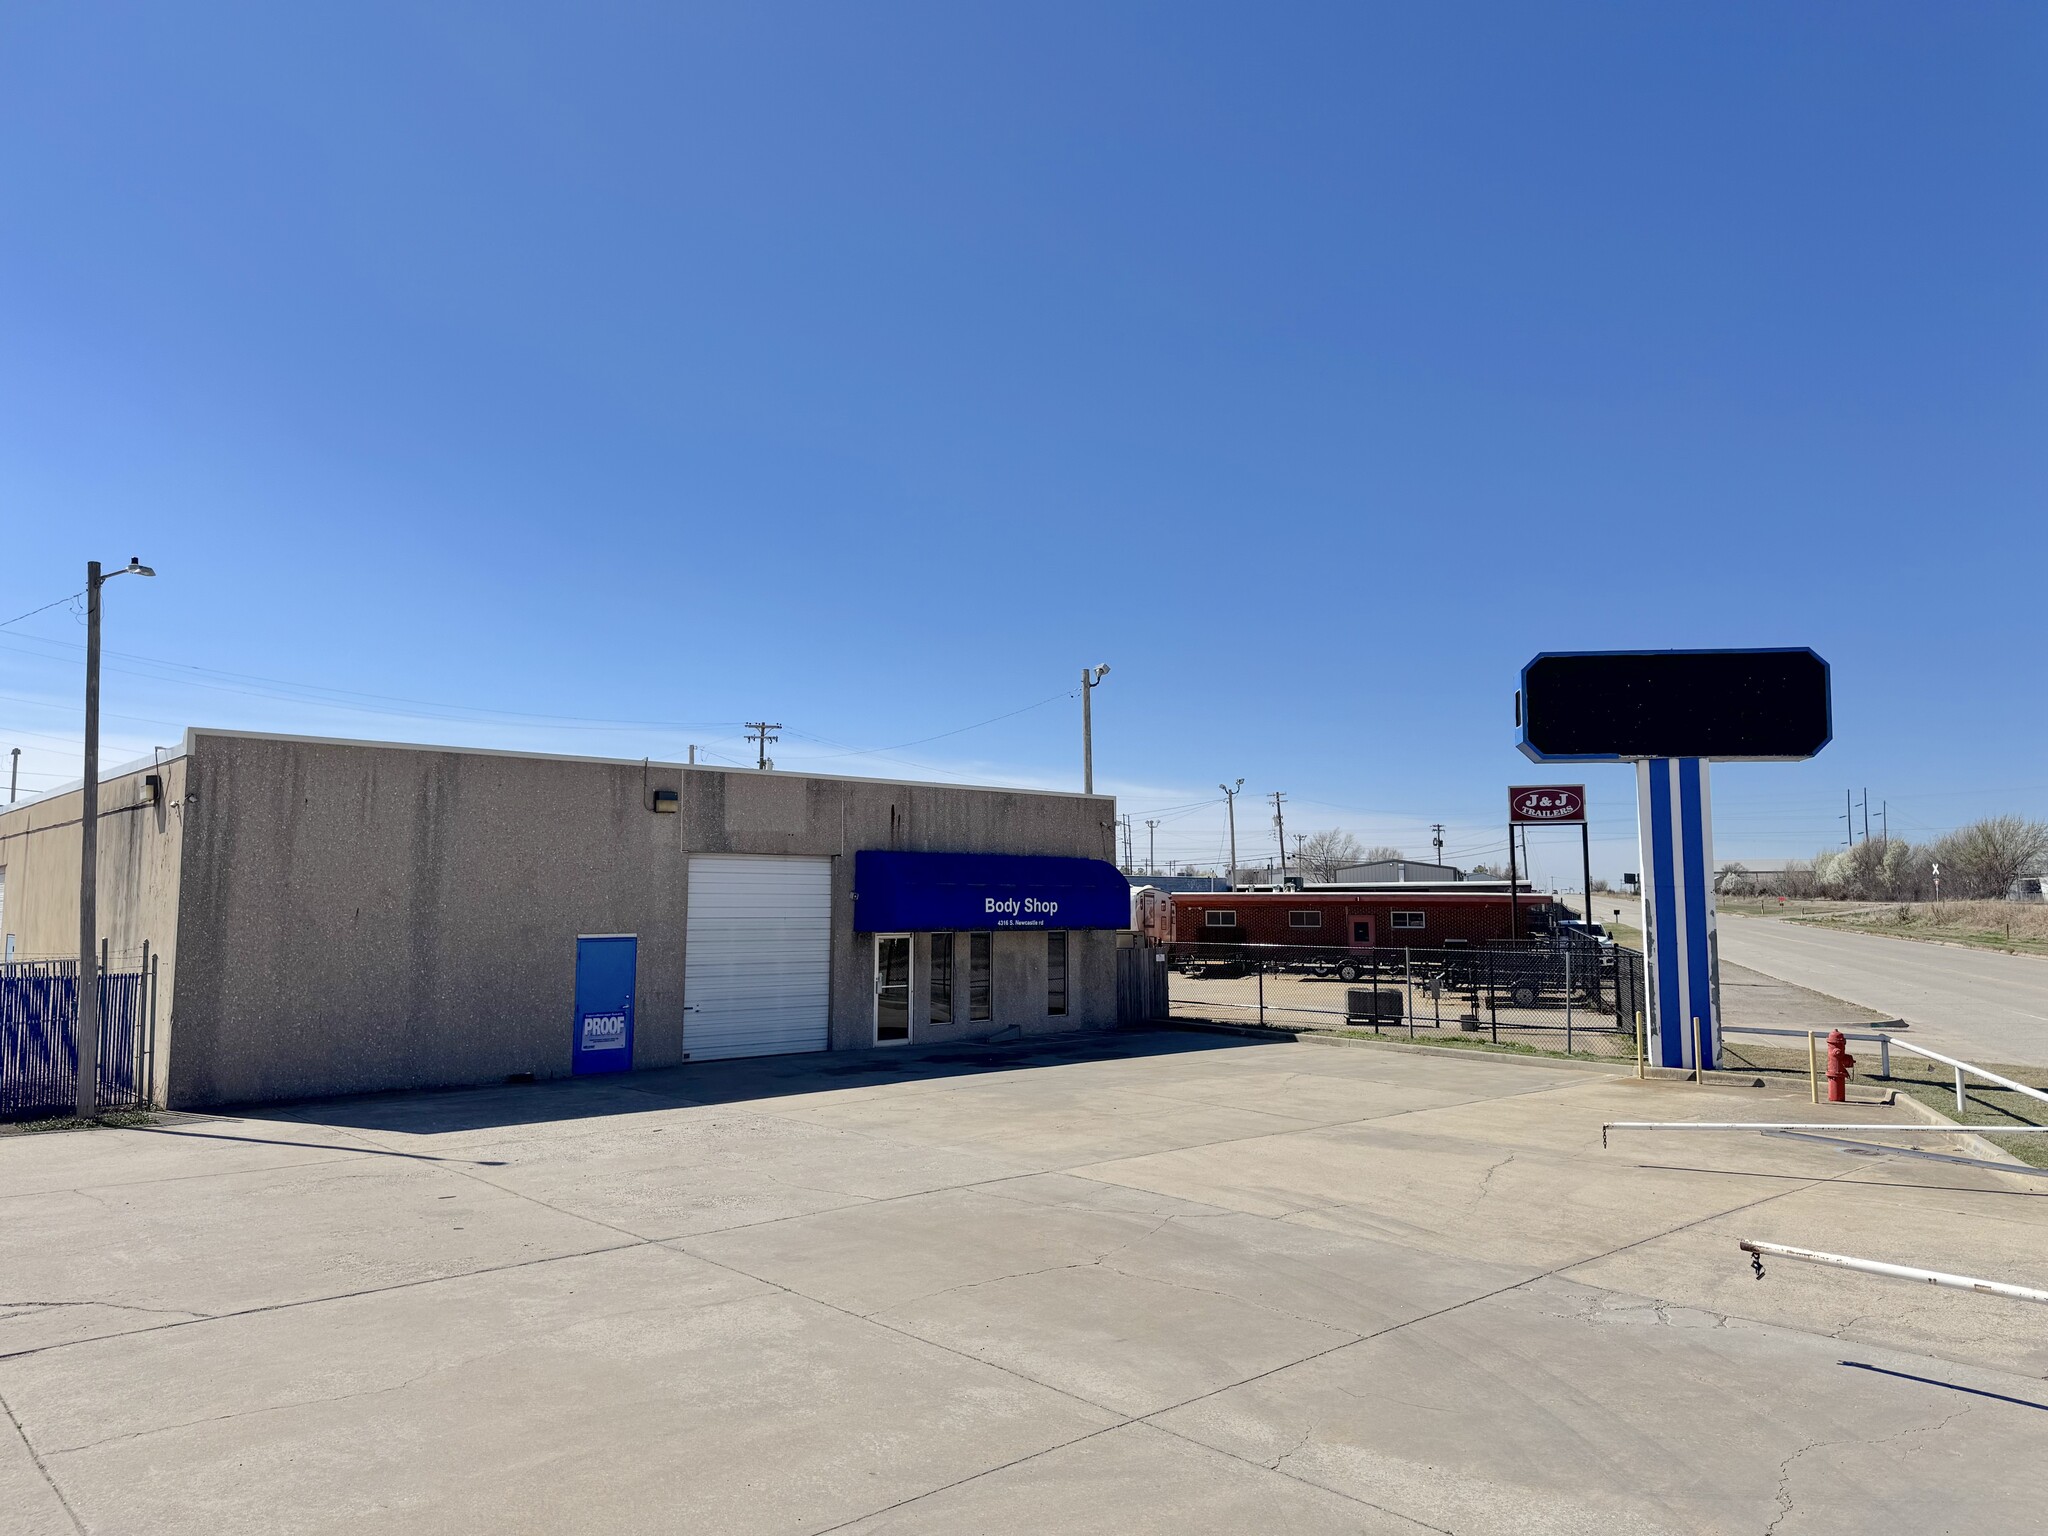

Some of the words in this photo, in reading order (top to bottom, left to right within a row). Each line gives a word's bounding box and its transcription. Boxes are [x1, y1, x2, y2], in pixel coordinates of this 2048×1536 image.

[1525, 794, 1539, 807] J
[1539, 796, 1552, 807] &
[1554, 793, 1568, 806] J
[1521, 805, 1574, 817] TRAILERS
[985, 898, 1020, 916] Body
[1024, 898, 1058, 916] Shop
[584, 1016, 625, 1035] PROOF
